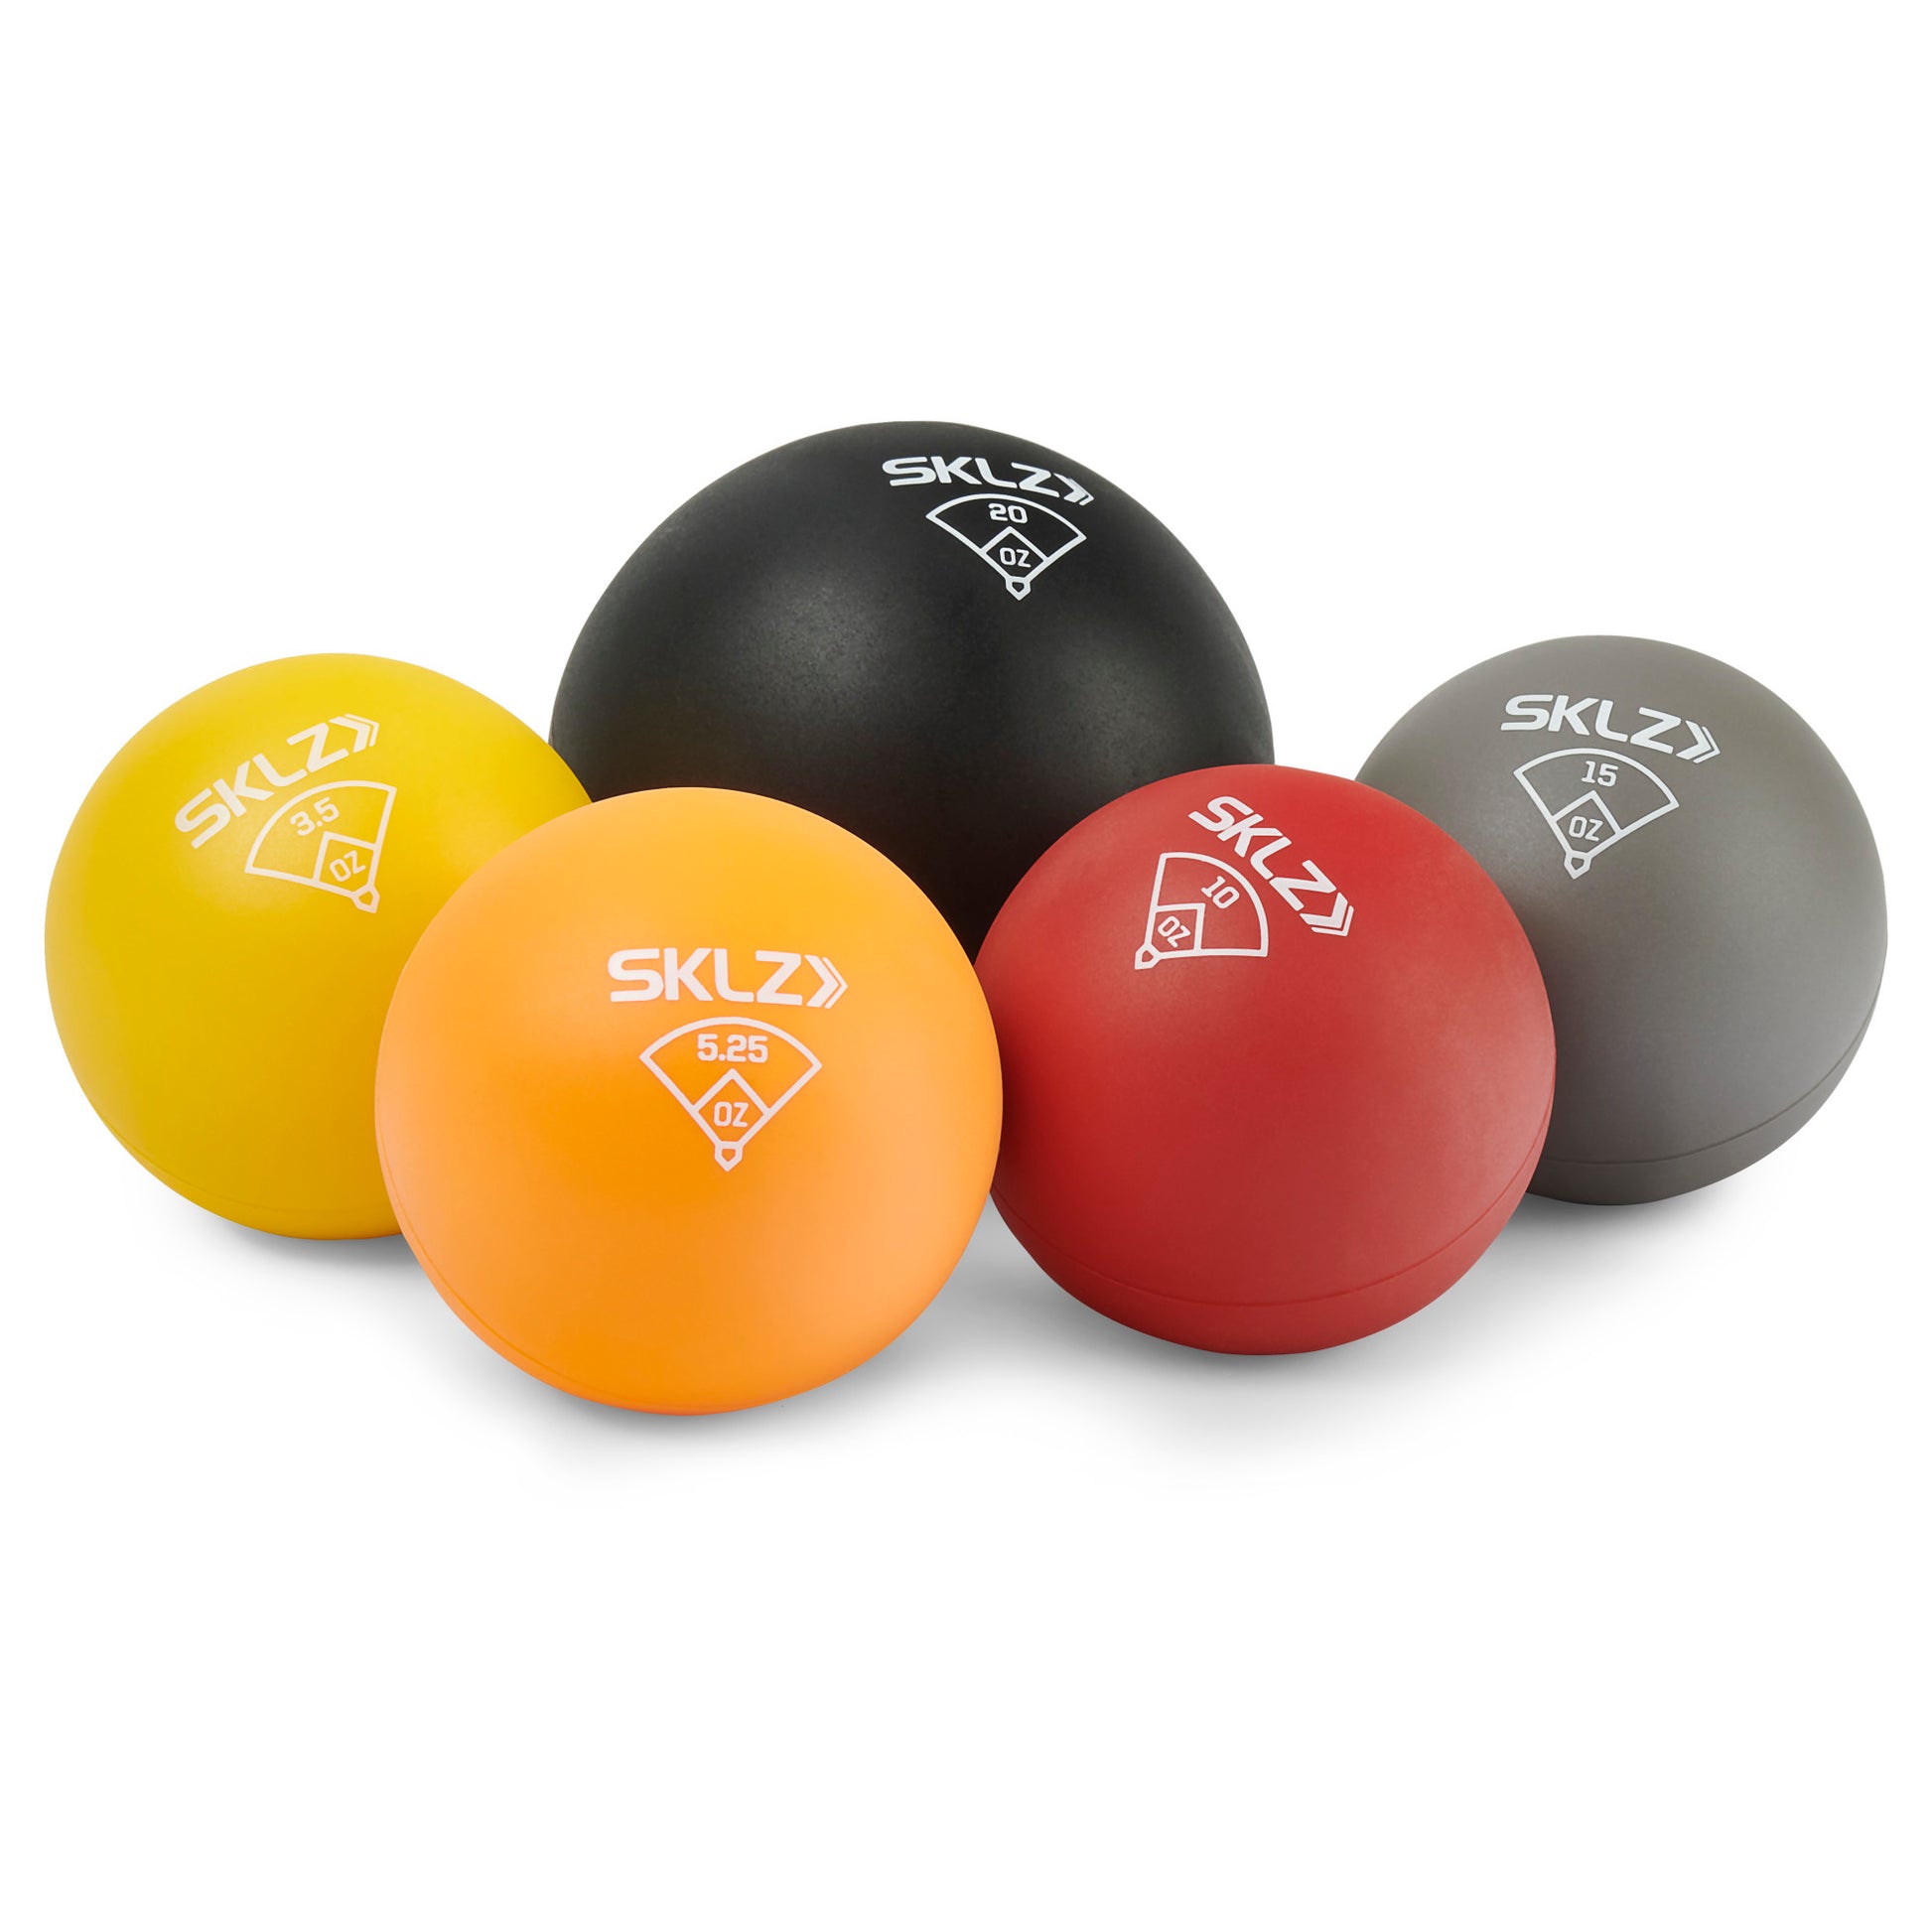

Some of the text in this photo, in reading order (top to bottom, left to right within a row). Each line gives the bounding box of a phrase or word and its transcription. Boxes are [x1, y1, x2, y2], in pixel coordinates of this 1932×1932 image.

[882, 456, 1060, 497] SKLZ
[988, 502, 1029, 524] 20
[999, 547, 1032, 568] OZ
[1500, 694, 1682, 755] SKLZ
[174, 722, 350, 850] SKLZ
[1581, 760, 1619, 787] 15
[289, 796, 340, 837] 3.5
[1568, 815, 1603, 842] OZ
[329, 849, 367, 883] OZ
[1187, 795, 1337, 911] SKLZ
[1200, 875, 1240, 909] 10
[1157, 915, 1191, 948] OZ
[607, 947, 803, 1007] SKLZ
[696, 1033, 768, 1063] 5.25
[713, 1100, 750, 1128] OZ
